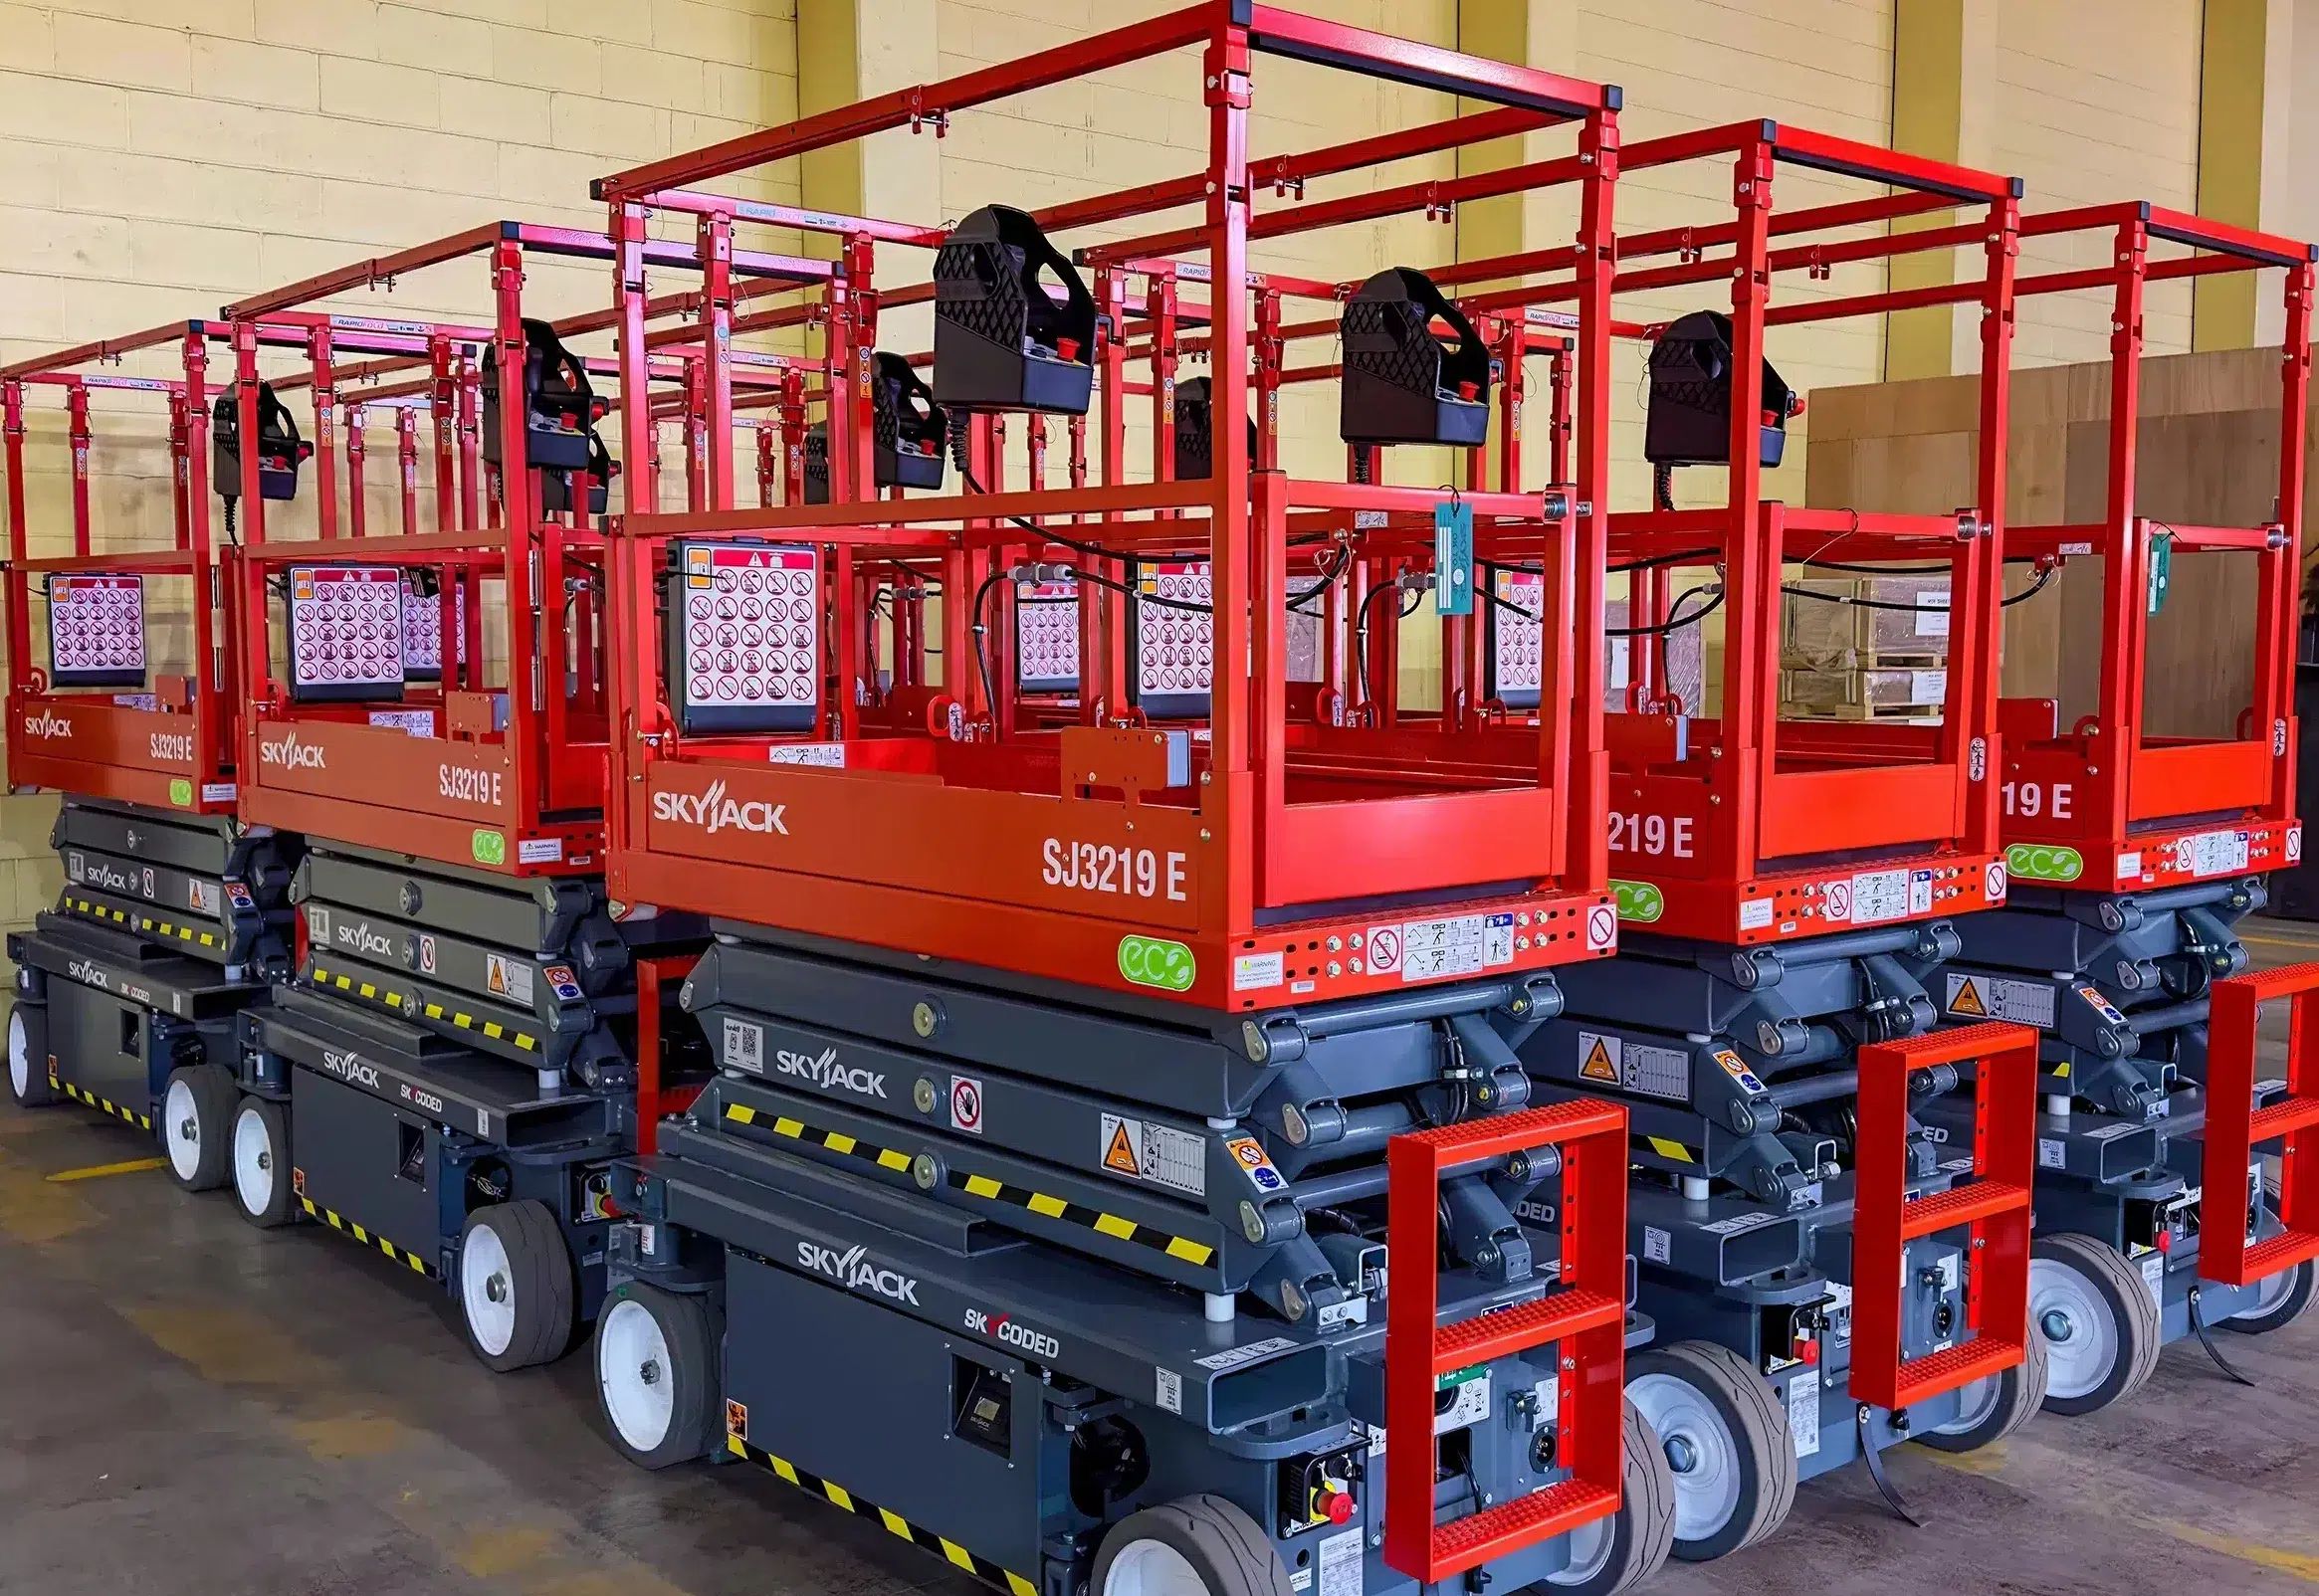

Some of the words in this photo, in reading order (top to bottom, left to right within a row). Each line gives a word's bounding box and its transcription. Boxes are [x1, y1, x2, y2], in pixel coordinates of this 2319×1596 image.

[25, 708, 72, 740] SKYJACK
[150, 732, 185, 759] SJ3219
[186, 736, 193, 761] E
[261, 731, 326, 770] SKYJACK
[439, 764, 488, 803] SJ3219
[493, 772, 502, 806] E
[2052, 783, 2072, 819] E
[654, 779, 789, 835] SKYJACK
[1674, 817, 1693, 858] E
[88, 863, 126, 891] SKYJACK
[1042, 838, 1157, 898] SJ3219
[1167, 851, 1186, 901] E
[338, 922, 392, 956] SKYJACK
[69, 960, 108, 988] SKYJACK
[323, 1051, 380, 1090] SKYJACK
[776, 1047, 888, 1099] SKYJACK
[797, 1240, 920, 1306] SKYJACK
[963, 1307, 1060, 1359] SKYCODED
